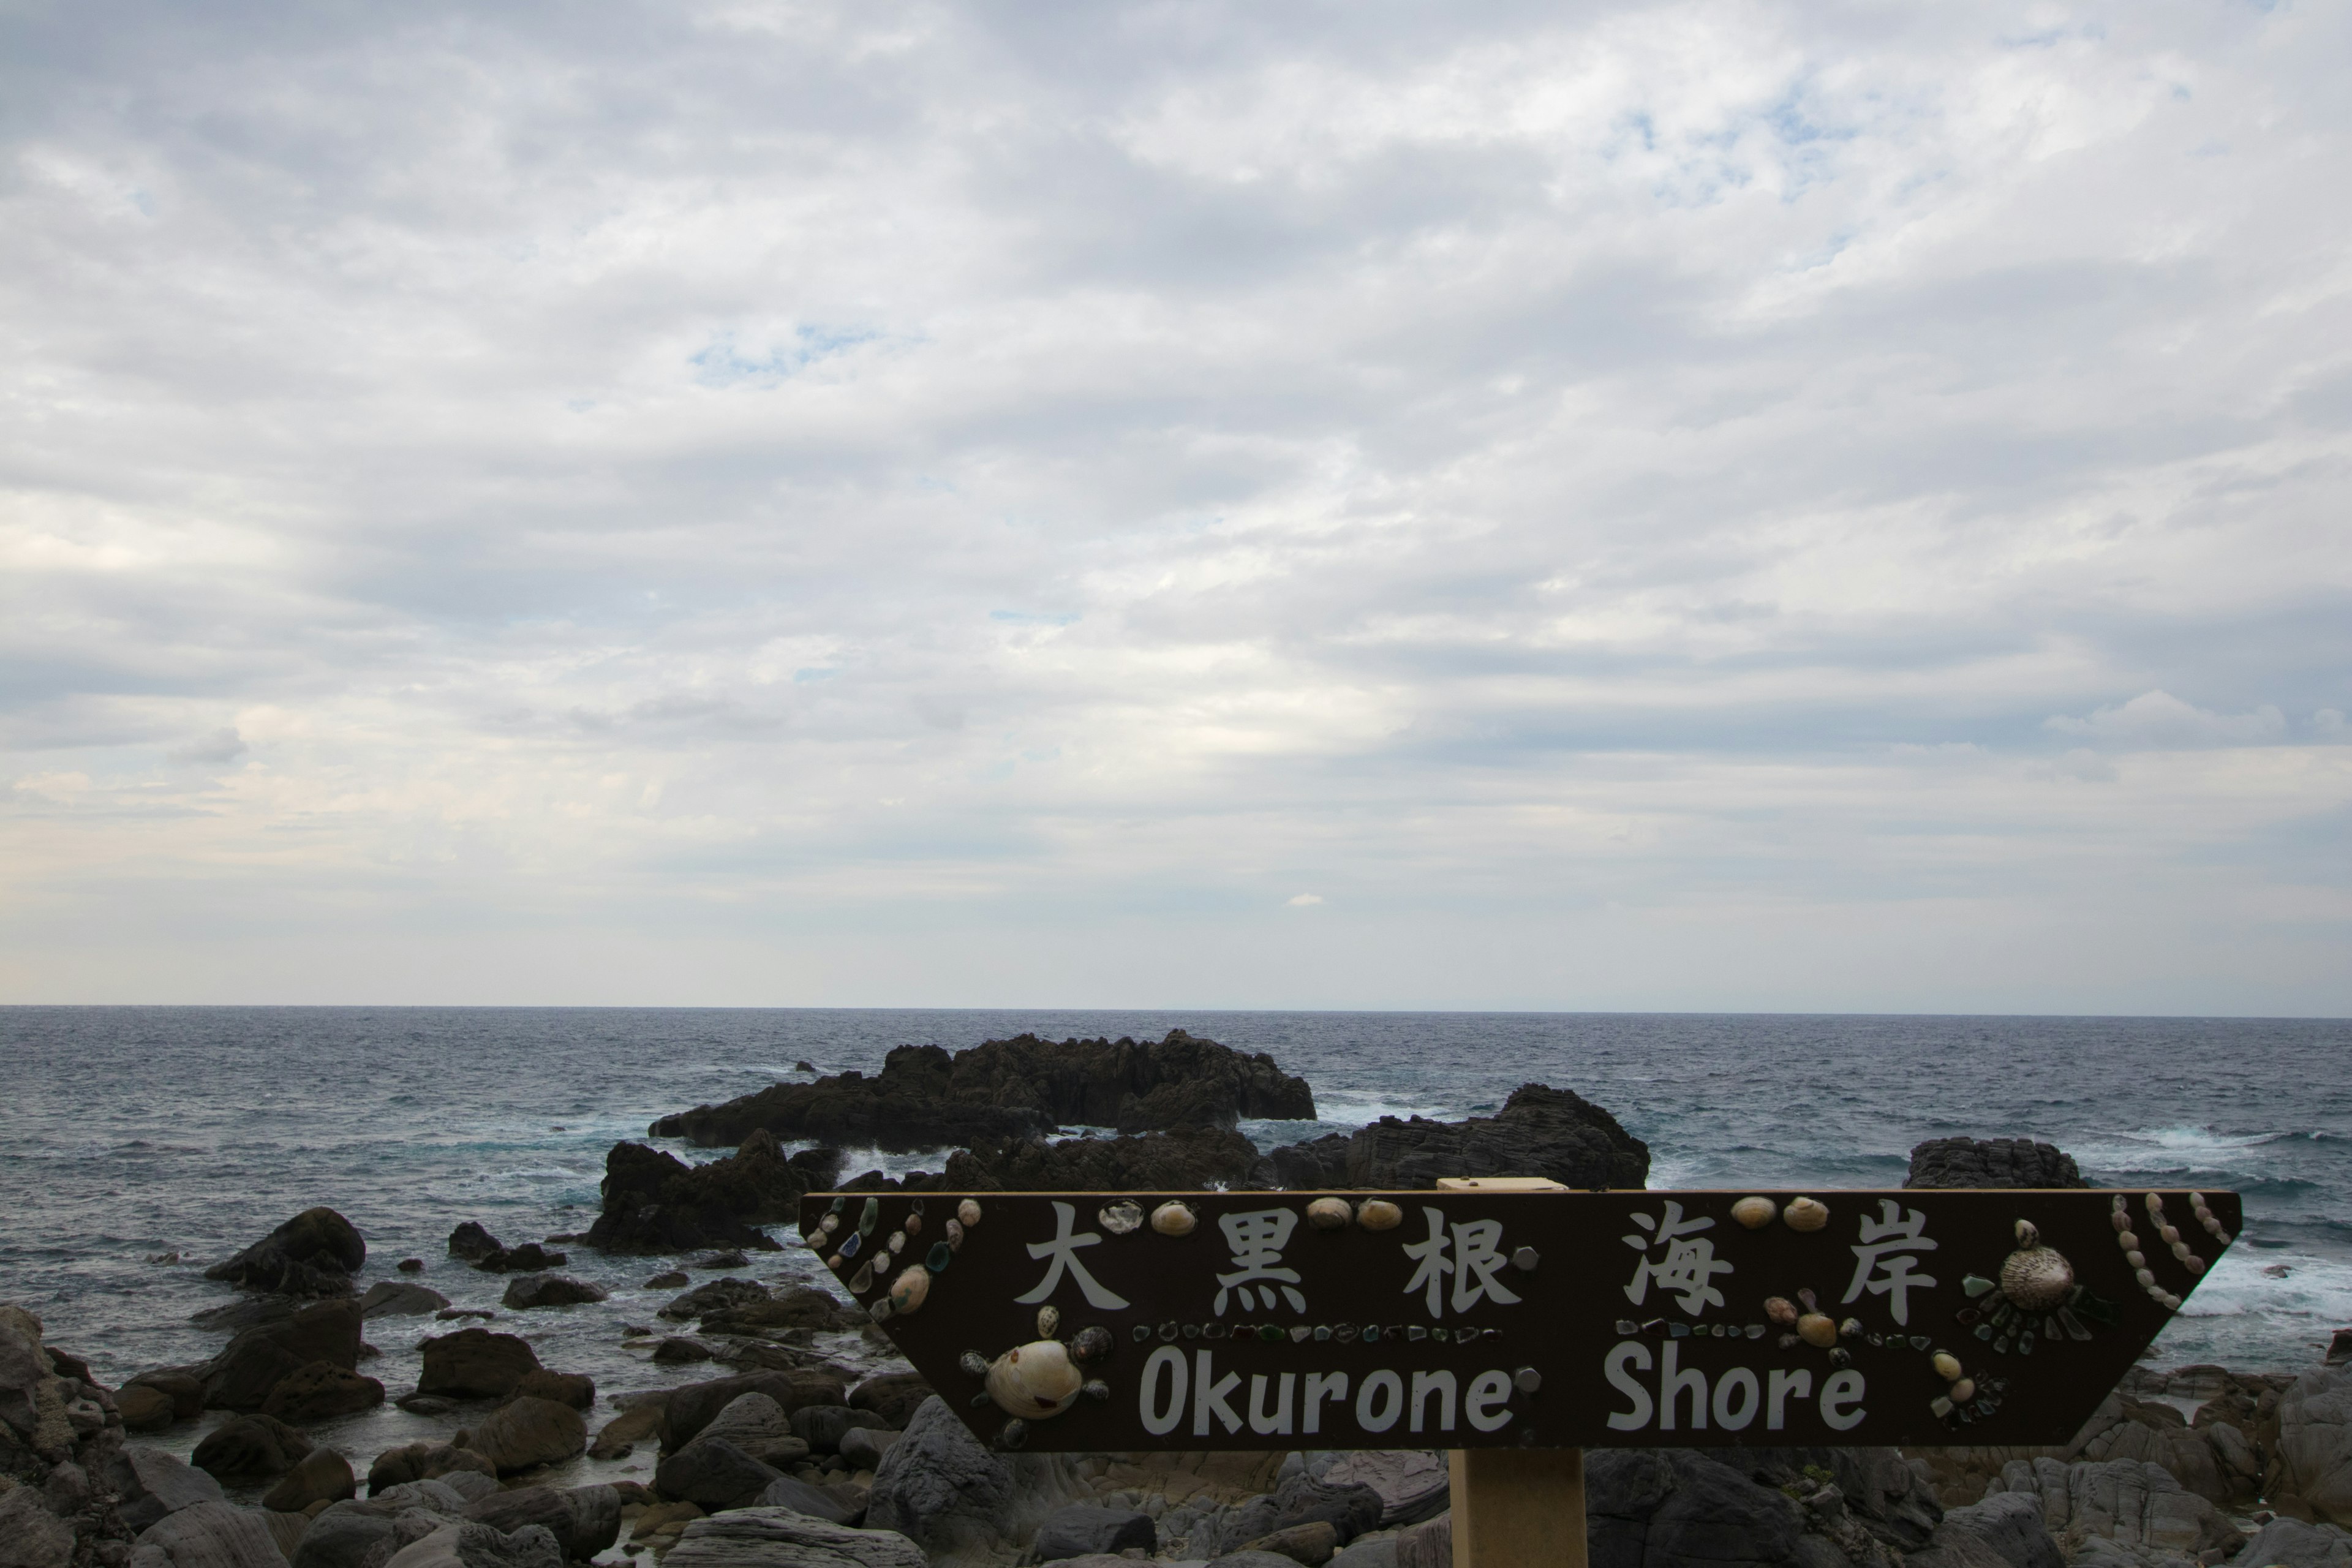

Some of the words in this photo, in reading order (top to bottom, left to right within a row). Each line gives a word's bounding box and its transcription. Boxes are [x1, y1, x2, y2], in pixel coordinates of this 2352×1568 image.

[1014, 1199, 1938, 1325] 大黒根海岸
[1140, 1346, 1513, 1435] Okurone
[1604, 1341, 1866, 1431] Shore
